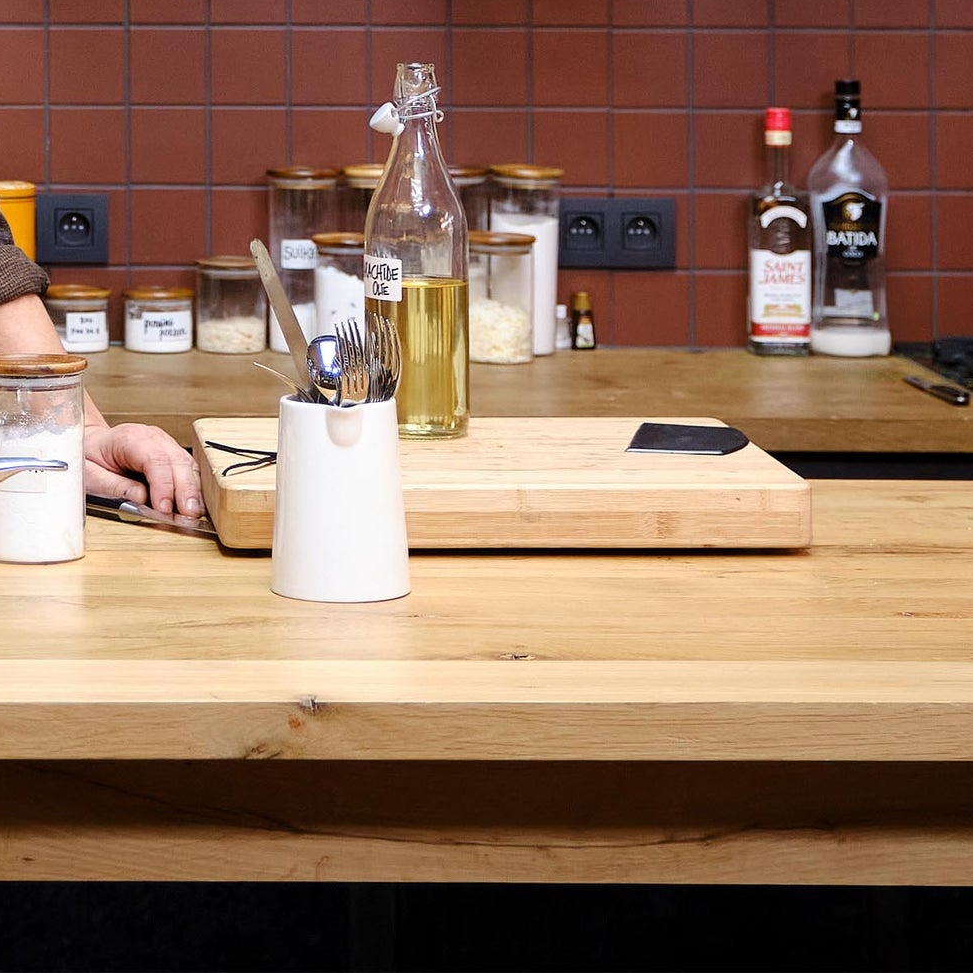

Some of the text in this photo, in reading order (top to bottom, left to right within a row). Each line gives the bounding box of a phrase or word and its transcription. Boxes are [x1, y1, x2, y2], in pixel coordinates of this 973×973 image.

[826, 230, 878, 246] BATIDA
[764, 260, 804, 272] SAINT
[758, 273, 806, 285] JAMES
